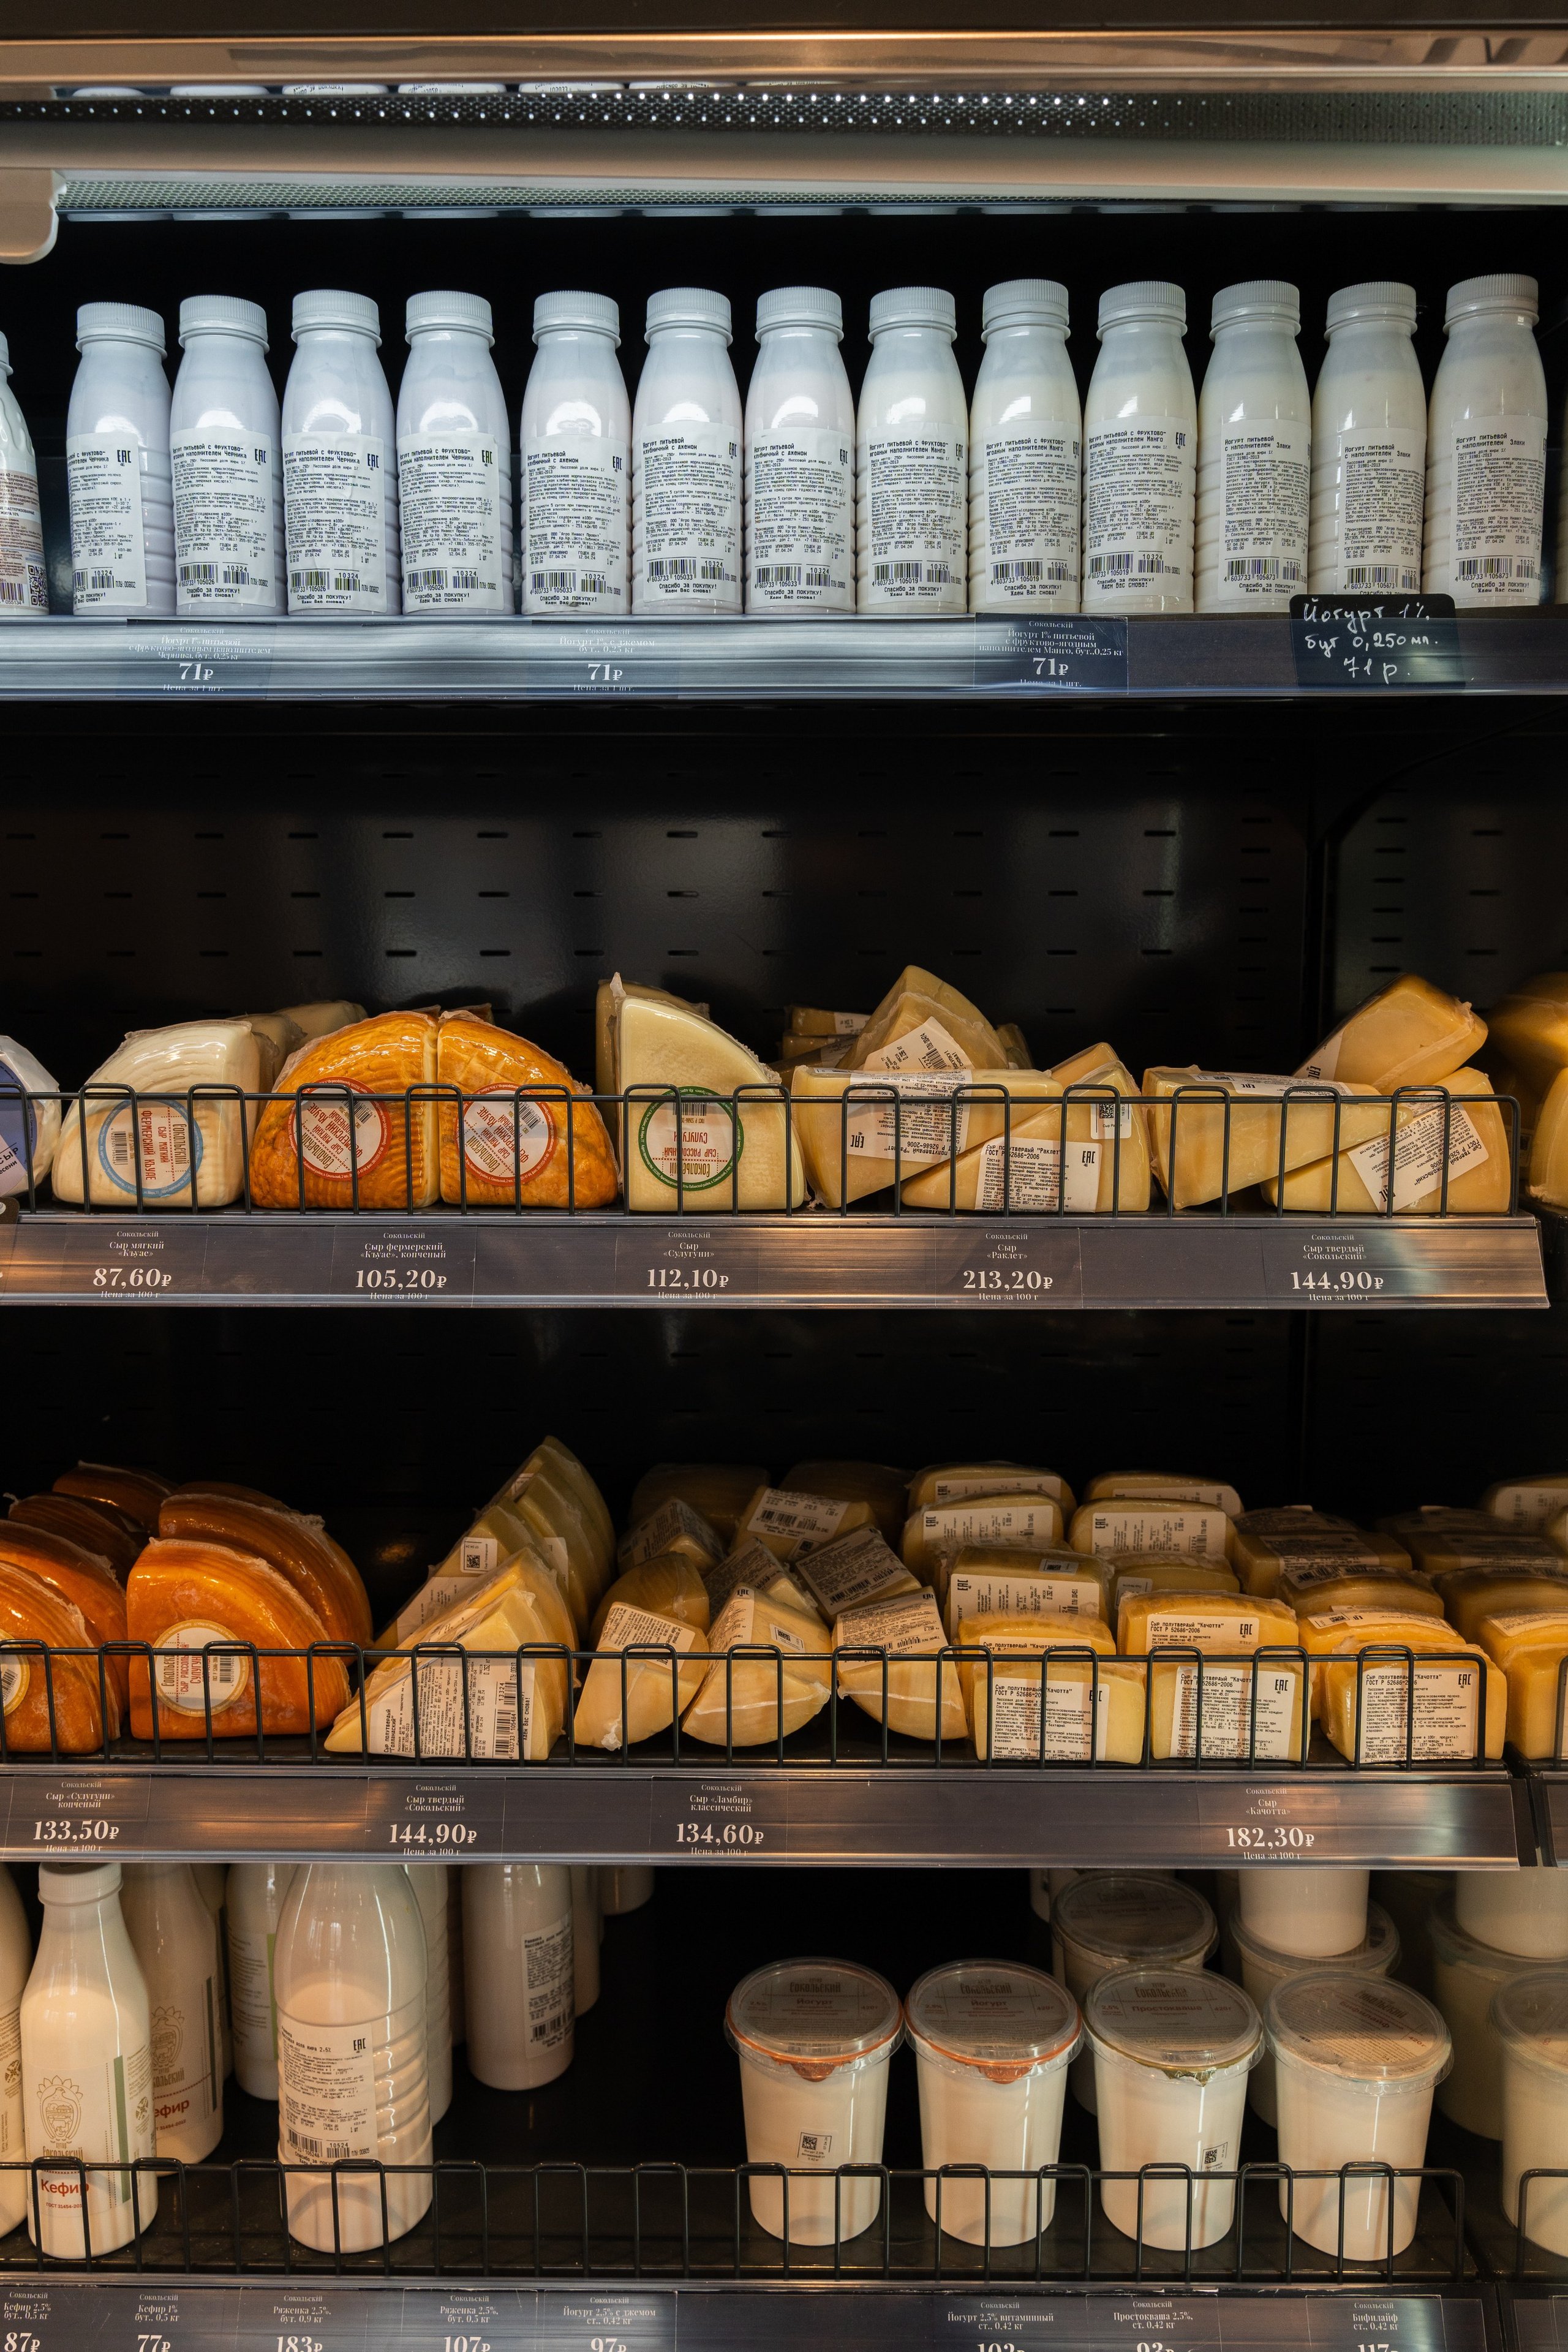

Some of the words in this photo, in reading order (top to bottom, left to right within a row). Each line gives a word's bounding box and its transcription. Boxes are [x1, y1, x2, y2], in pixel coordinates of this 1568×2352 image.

[986, 441, 1002, 451] Йогурт
[481, 450, 492, 464] EAC
[1008, 628, 1039, 639] Йогурт
[1054, 632, 1095, 641] питьевой
[161, 635, 190, 645] Йогурт
[560, 636, 594, 647] Йогурт
[1012, 638, 1096, 648] фруктово-ягодным
[1344, 657, 1372, 678] 71
[159, 1142, 171, 1164] МЯГКИЙ
[1082, 1151, 1095, 1163] EAC
[386, 1243, 443, 1252] фермерский
[998, 1244, 1016, 1253] Сыр
[1303, 1245, 1322, 1253] Сыр
[1325, 1245, 1364, 1253] твердый
[663, 1250, 714, 1258] «Сулугуни»
[1240, 1624, 1253, 1635] EAC
[46, 1792, 64, 1801] Сыр
[67, 1792, 115, 1801] «Сулугуни»
[407, 1795, 424, 1804] Сыр
[428, 1795, 464, 1804] твердый
[690, 1795, 708, 1804] Сыр
[710, 1795, 753, 1805] «Ламбир»
[58, 1800, 101, 1808] копченый
[1258, 1799, 1277, 1807] Сыр
[4, 2302, 31, 2313] Кефир
[138, 2304, 165, 2314] Кефир
[168, 2304, 178, 2313] 1%
[273, 2305, 309, 2315] Ряженка
[564, 2305, 593, 2318] Йогурт
[948, 2311, 978, 2323] Йогурт
[1000, 2313, 1054, 2323] витаминный
[1114, 2312, 1170, 2321] Простокваша
[1352, 2312, 1398, 2323] Бифилайф
